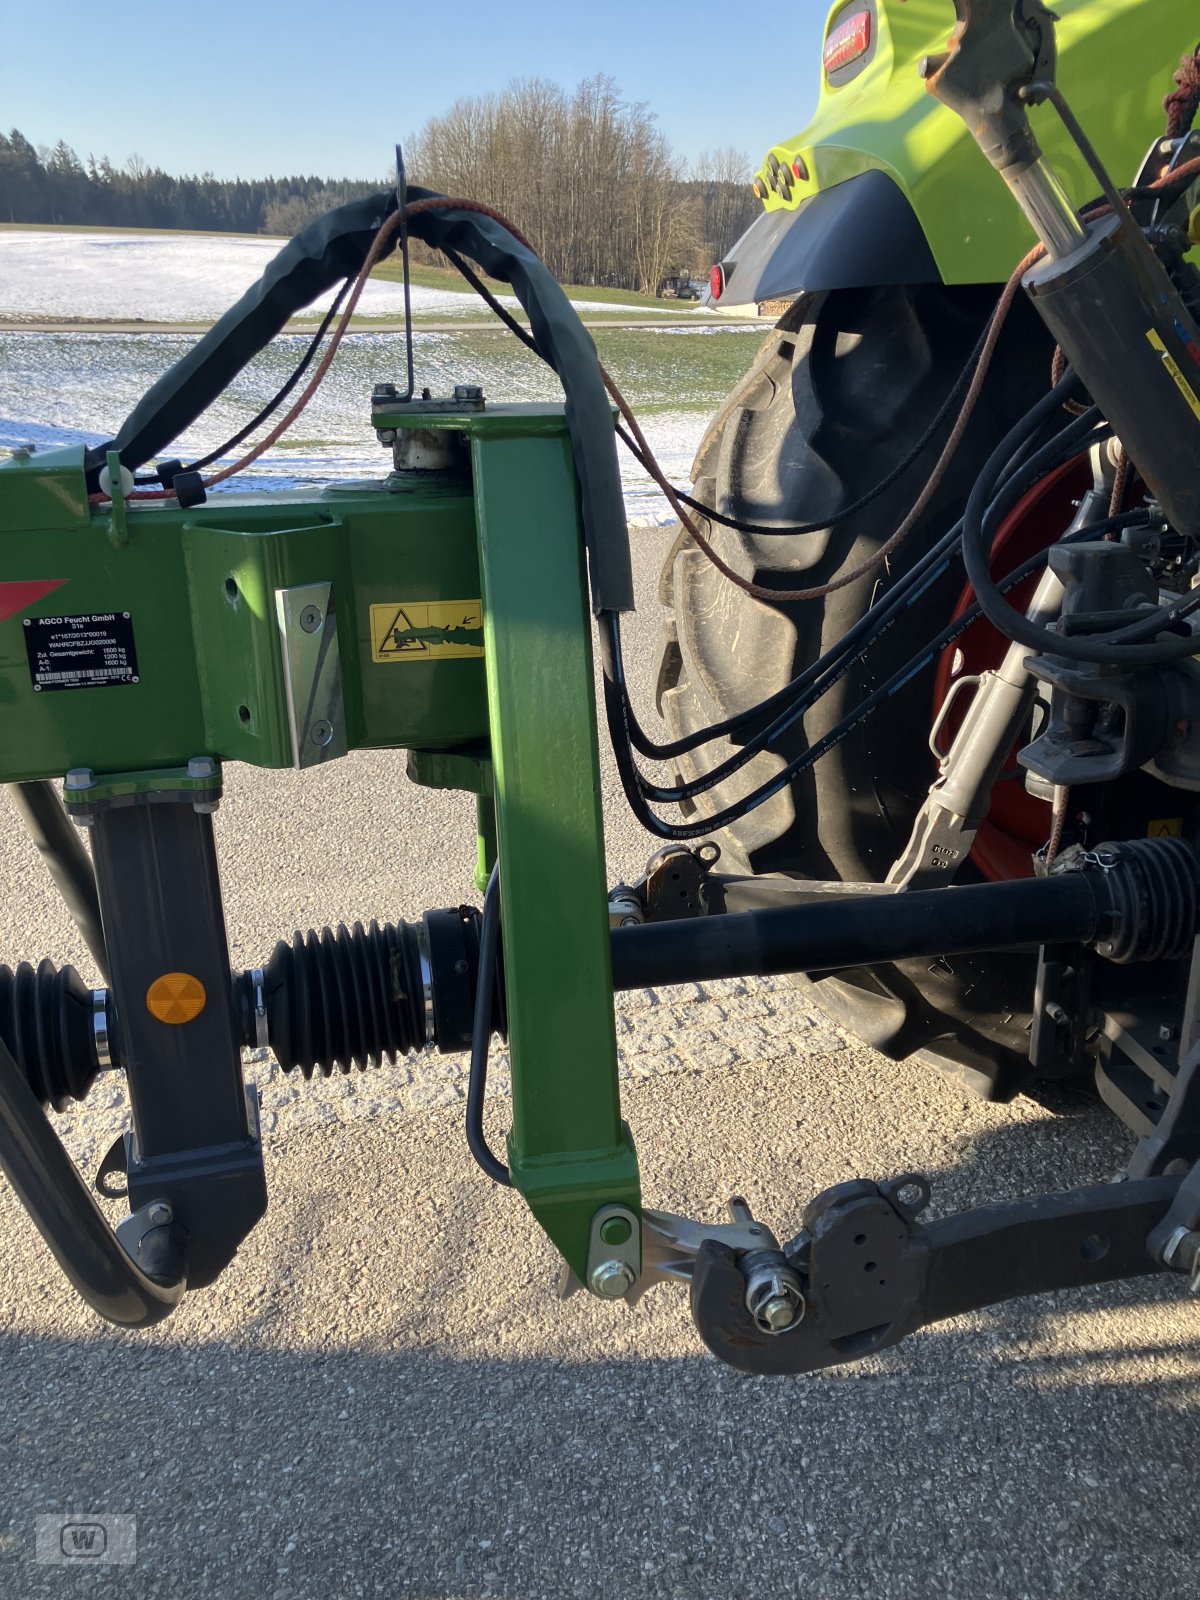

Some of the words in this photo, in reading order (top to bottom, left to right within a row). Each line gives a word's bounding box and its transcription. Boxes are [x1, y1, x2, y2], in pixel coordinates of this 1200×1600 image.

[39, 617, 63, 626] AGCO
[64, 616, 90, 624] Feucht
[91, 614, 115, 622] GmbH
[117, 646, 126, 654] kg
